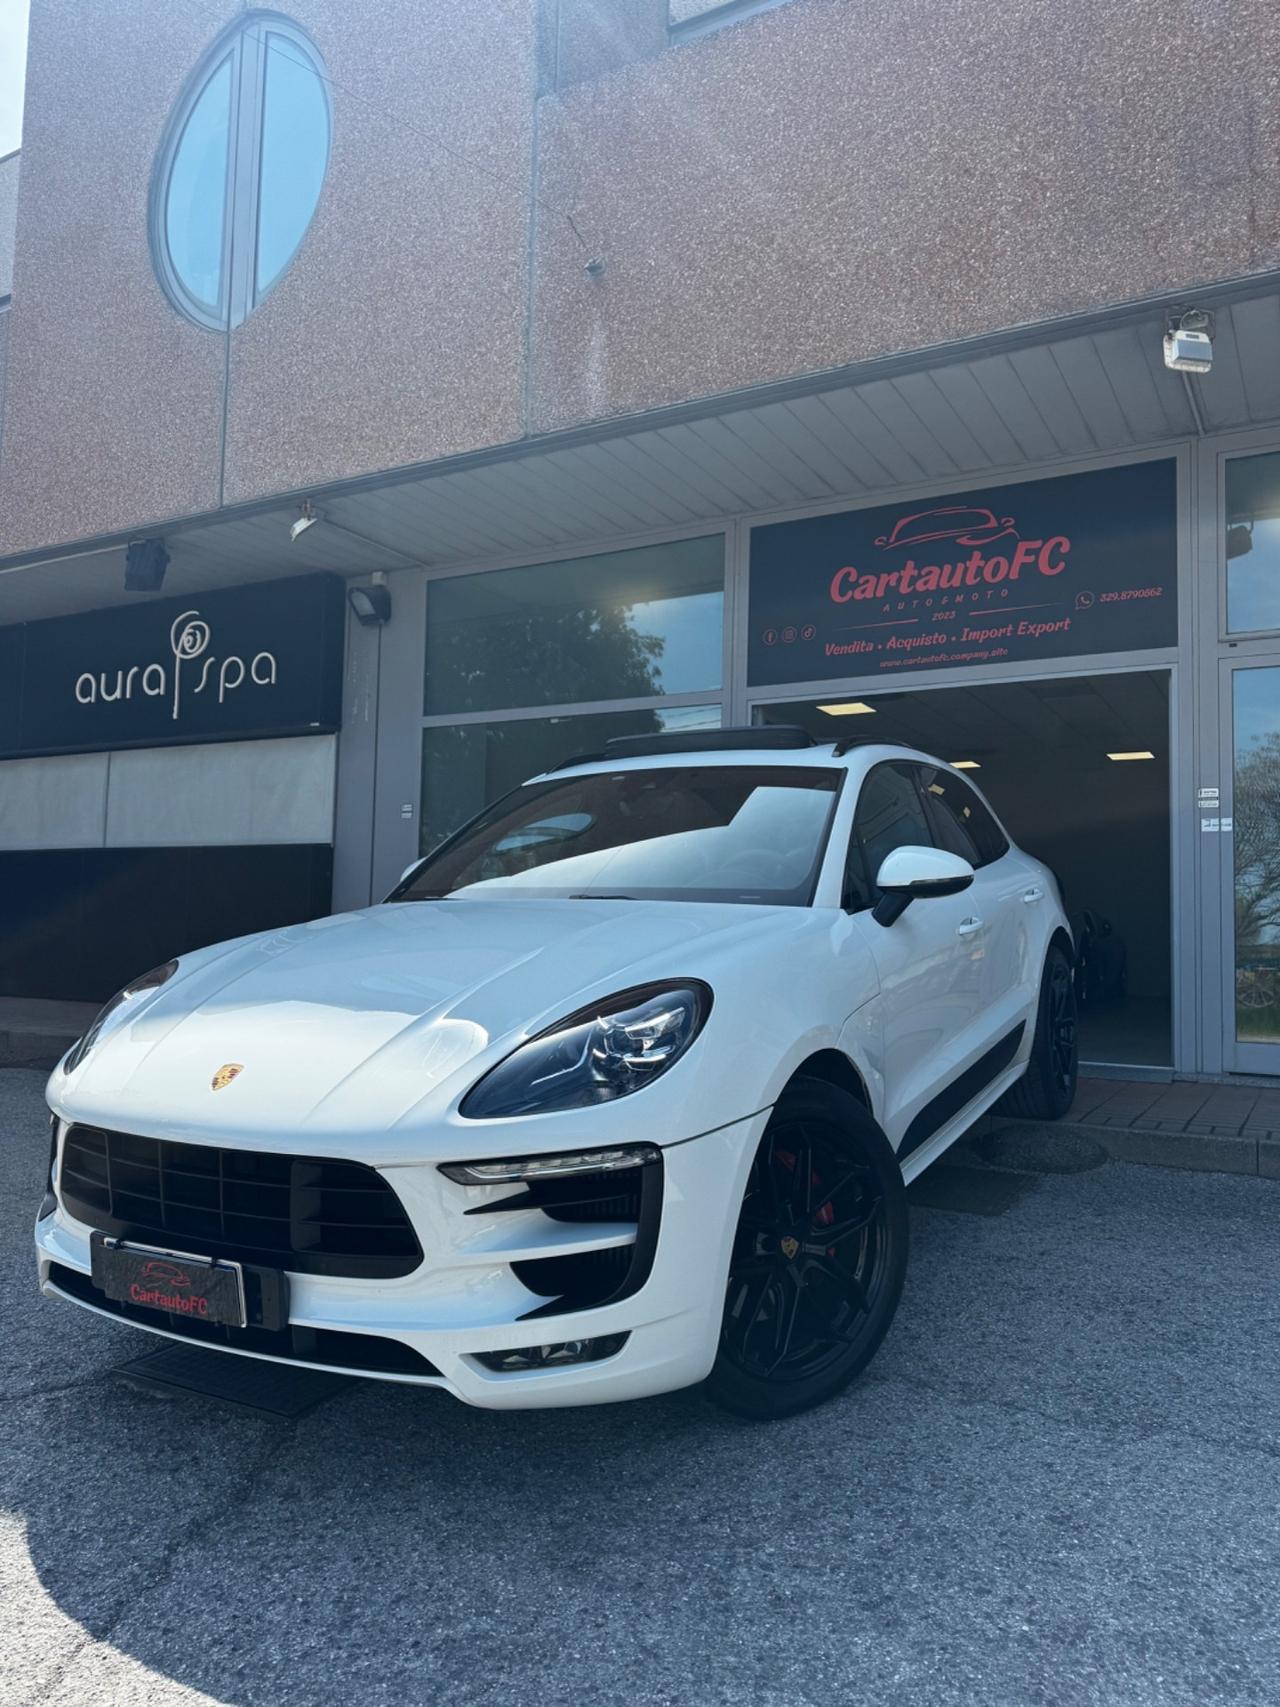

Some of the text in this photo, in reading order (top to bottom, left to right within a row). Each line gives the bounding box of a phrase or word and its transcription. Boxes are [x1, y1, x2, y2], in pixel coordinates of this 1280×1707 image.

[831, 536, 1071, 603] CartautoFC
[825, 618, 1072, 656] Vendita Acquisto Import Export
[75, 652, 276, 703] aura spa
[131, 1283, 209, 1315] CartautoFC
